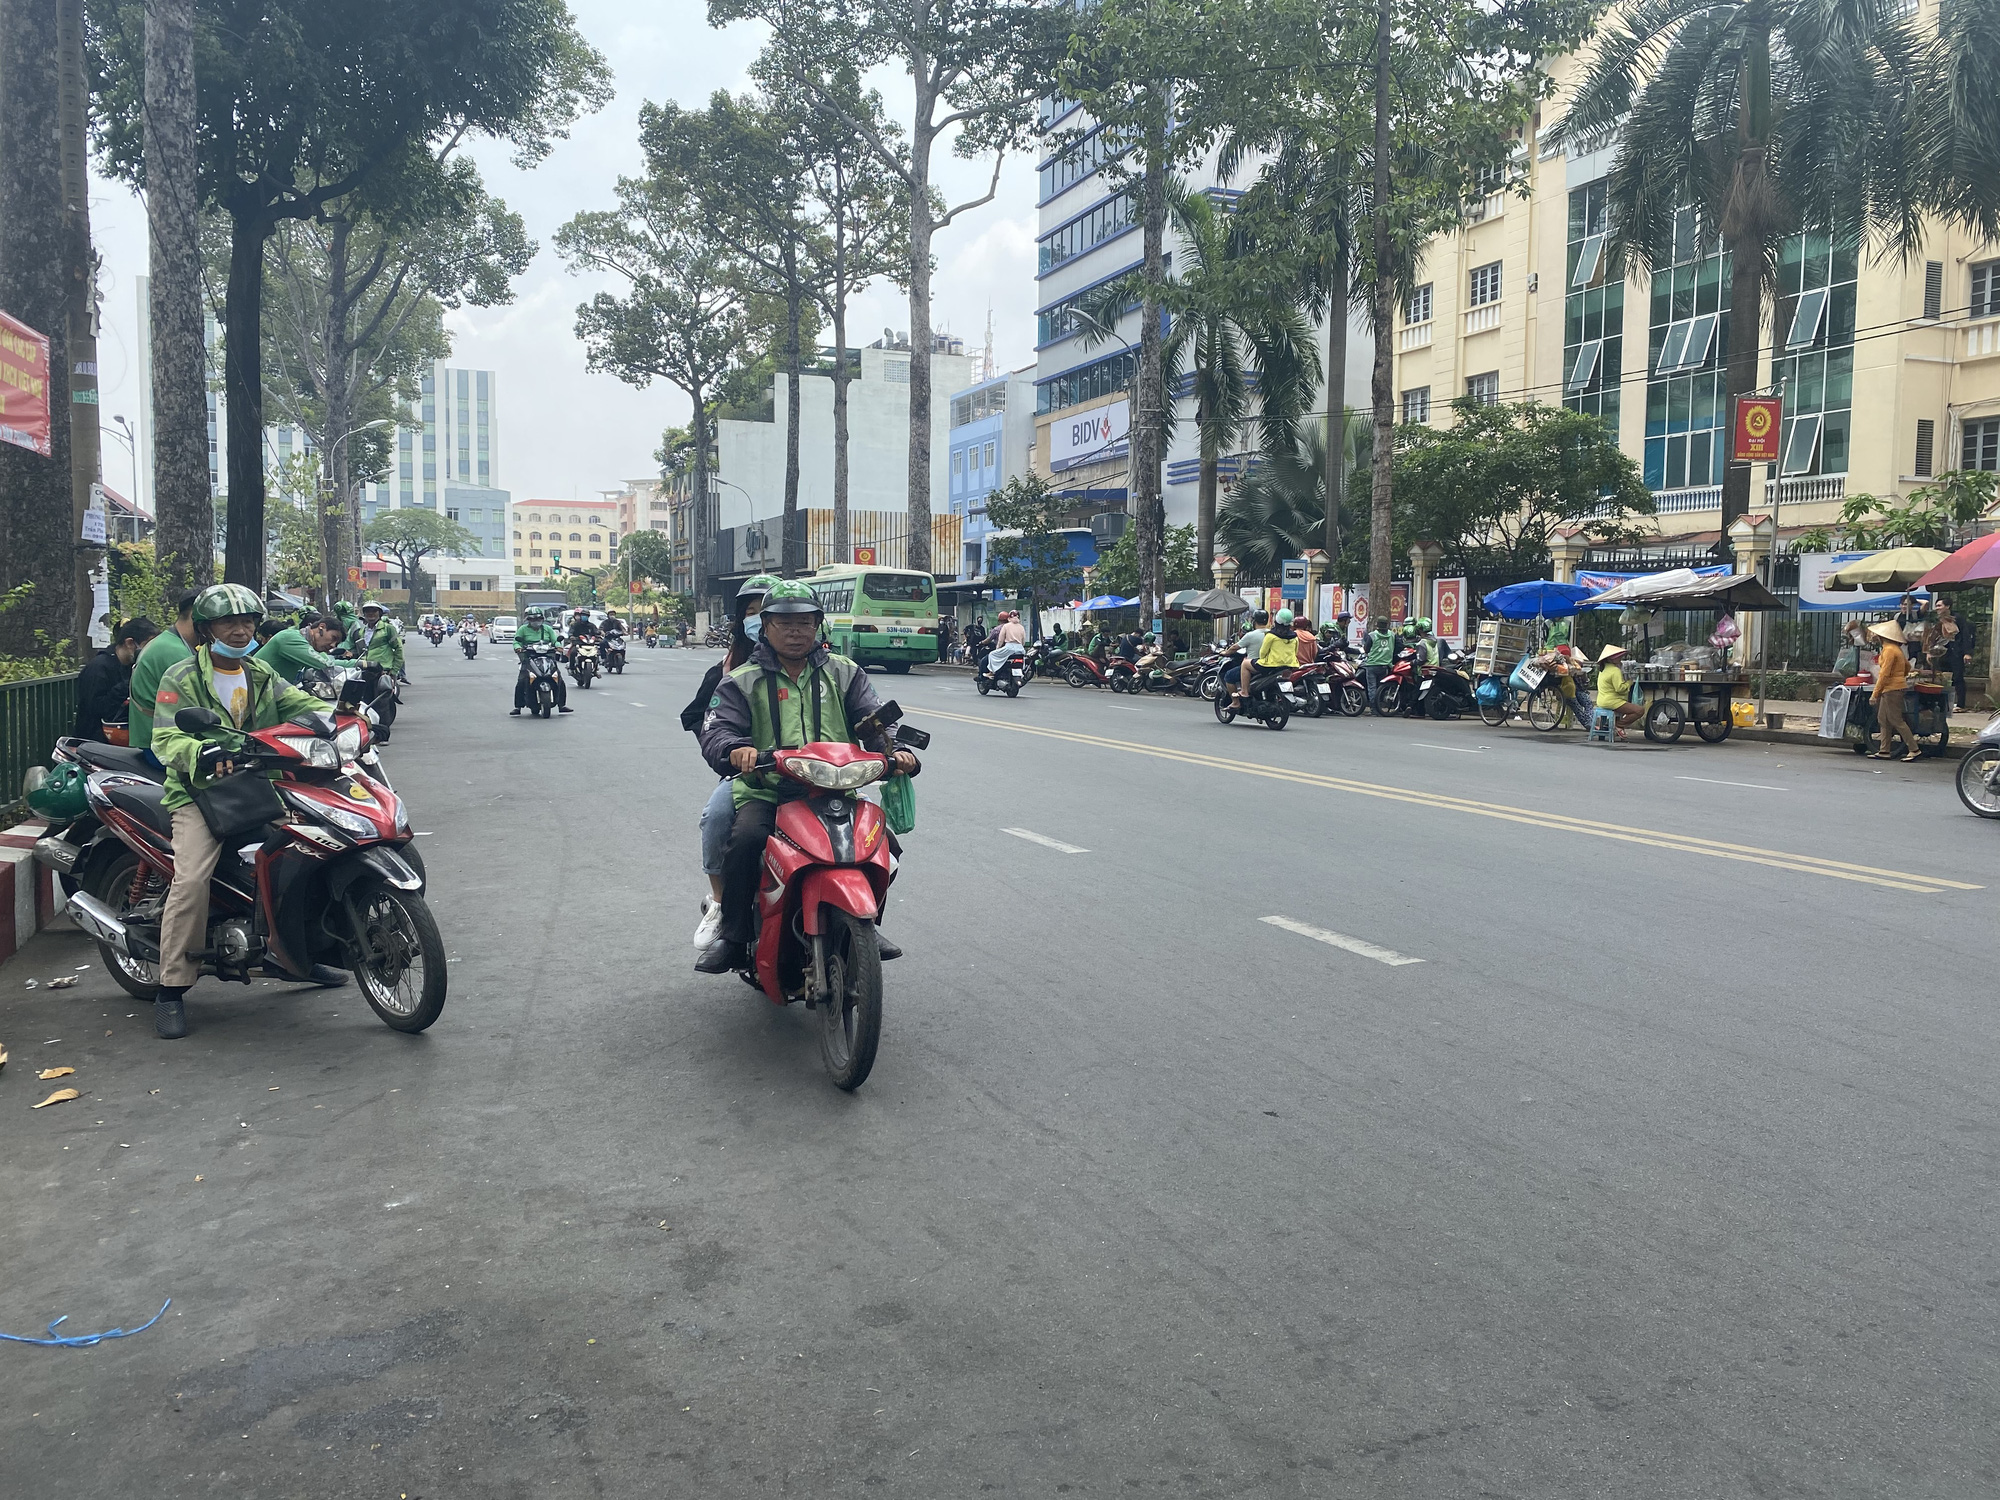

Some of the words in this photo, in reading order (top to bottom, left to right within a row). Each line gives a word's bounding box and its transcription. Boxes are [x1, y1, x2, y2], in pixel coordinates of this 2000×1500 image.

[1072, 417, 1100, 447] BIDV
[1749, 443, 1764, 451] XIII
[314, 836, 343, 850] 110
